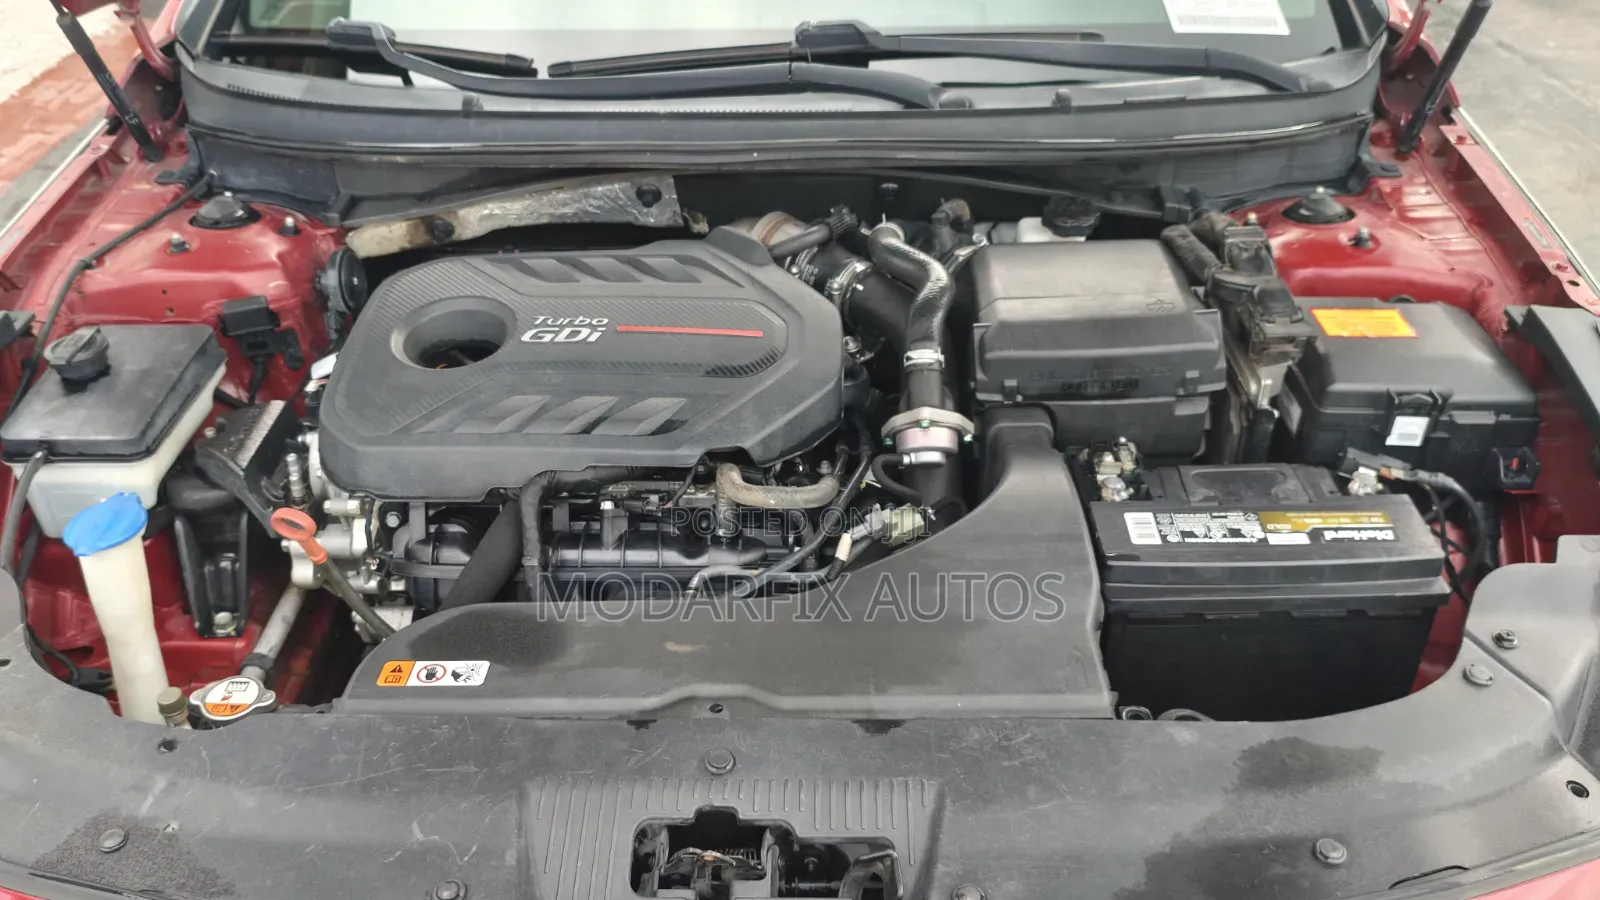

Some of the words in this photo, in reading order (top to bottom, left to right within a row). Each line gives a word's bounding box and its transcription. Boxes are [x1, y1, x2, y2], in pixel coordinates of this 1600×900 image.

[533, 316, 609, 325] Turbo
[521, 327, 607, 342] GDi
[1323, 530, 1396, 541] DieHard
